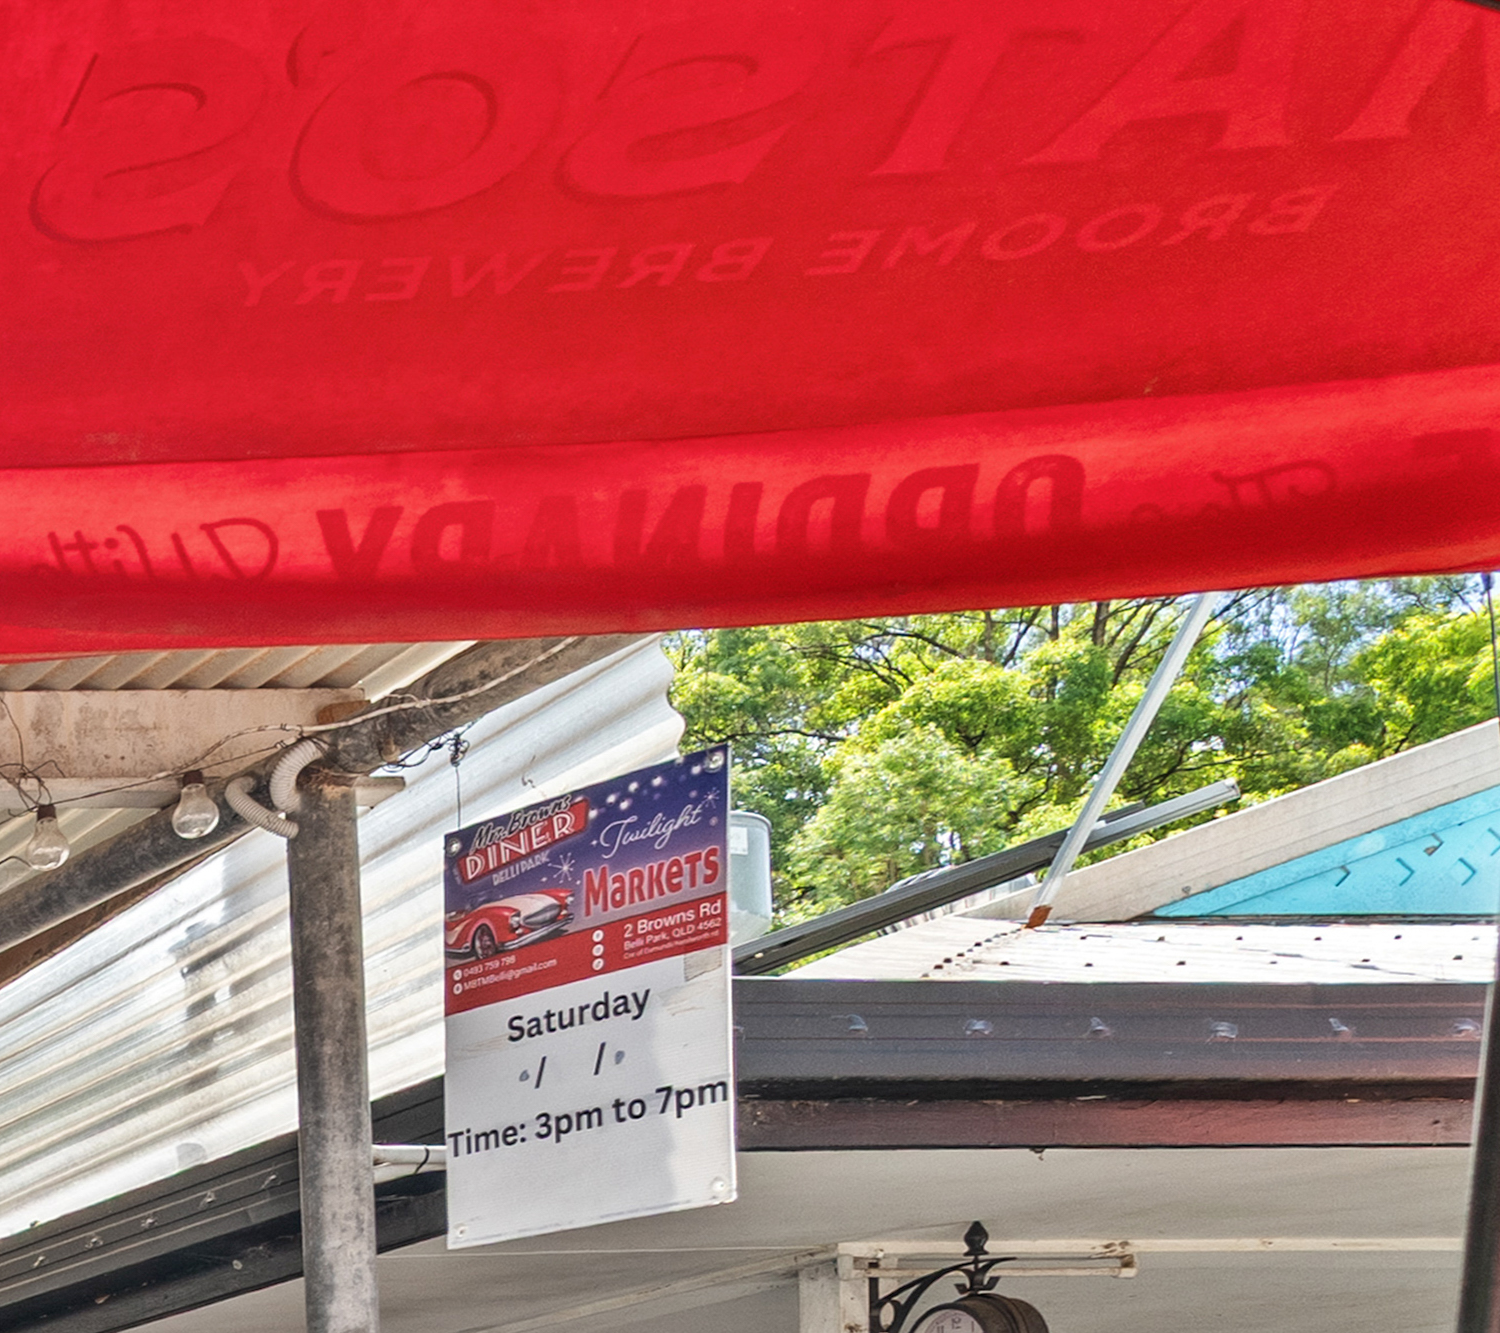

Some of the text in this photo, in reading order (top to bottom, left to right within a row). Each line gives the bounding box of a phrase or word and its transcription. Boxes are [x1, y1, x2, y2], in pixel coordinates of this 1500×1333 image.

[466, 812, 575, 880] DINER
[600, 800, 708, 859] Twilight
[624, 901, 721, 938] 2 Browns Rd
[672, 924, 694, 938] QLD
[508, 988, 650, 1043] Saturday
[447, 1080, 729, 1158] Time: 3pm to 7pm
